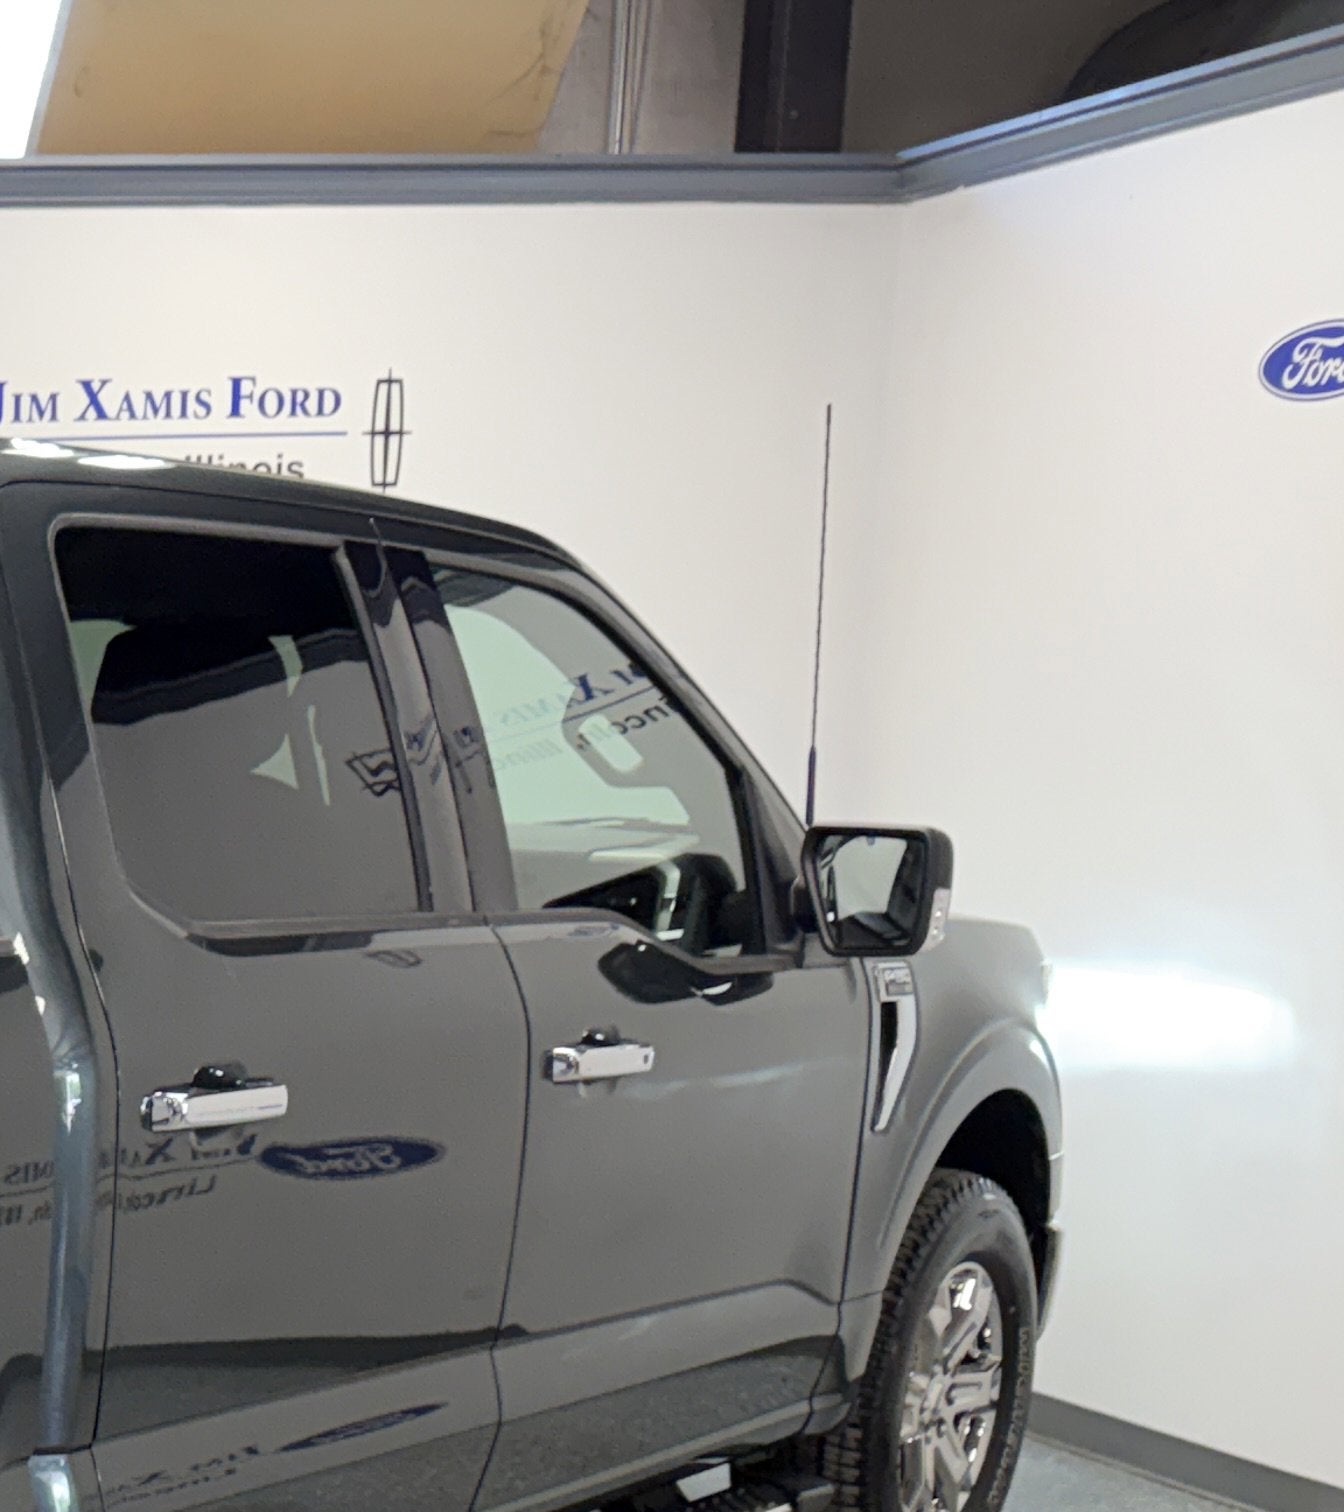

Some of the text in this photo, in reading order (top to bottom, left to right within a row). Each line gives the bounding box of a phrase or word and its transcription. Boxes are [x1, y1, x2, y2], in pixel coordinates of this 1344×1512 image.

[1281, 335, 1344, 390] For
[73, 378, 213, 422] XAMIS
[226, 375, 343, 419] FORD
